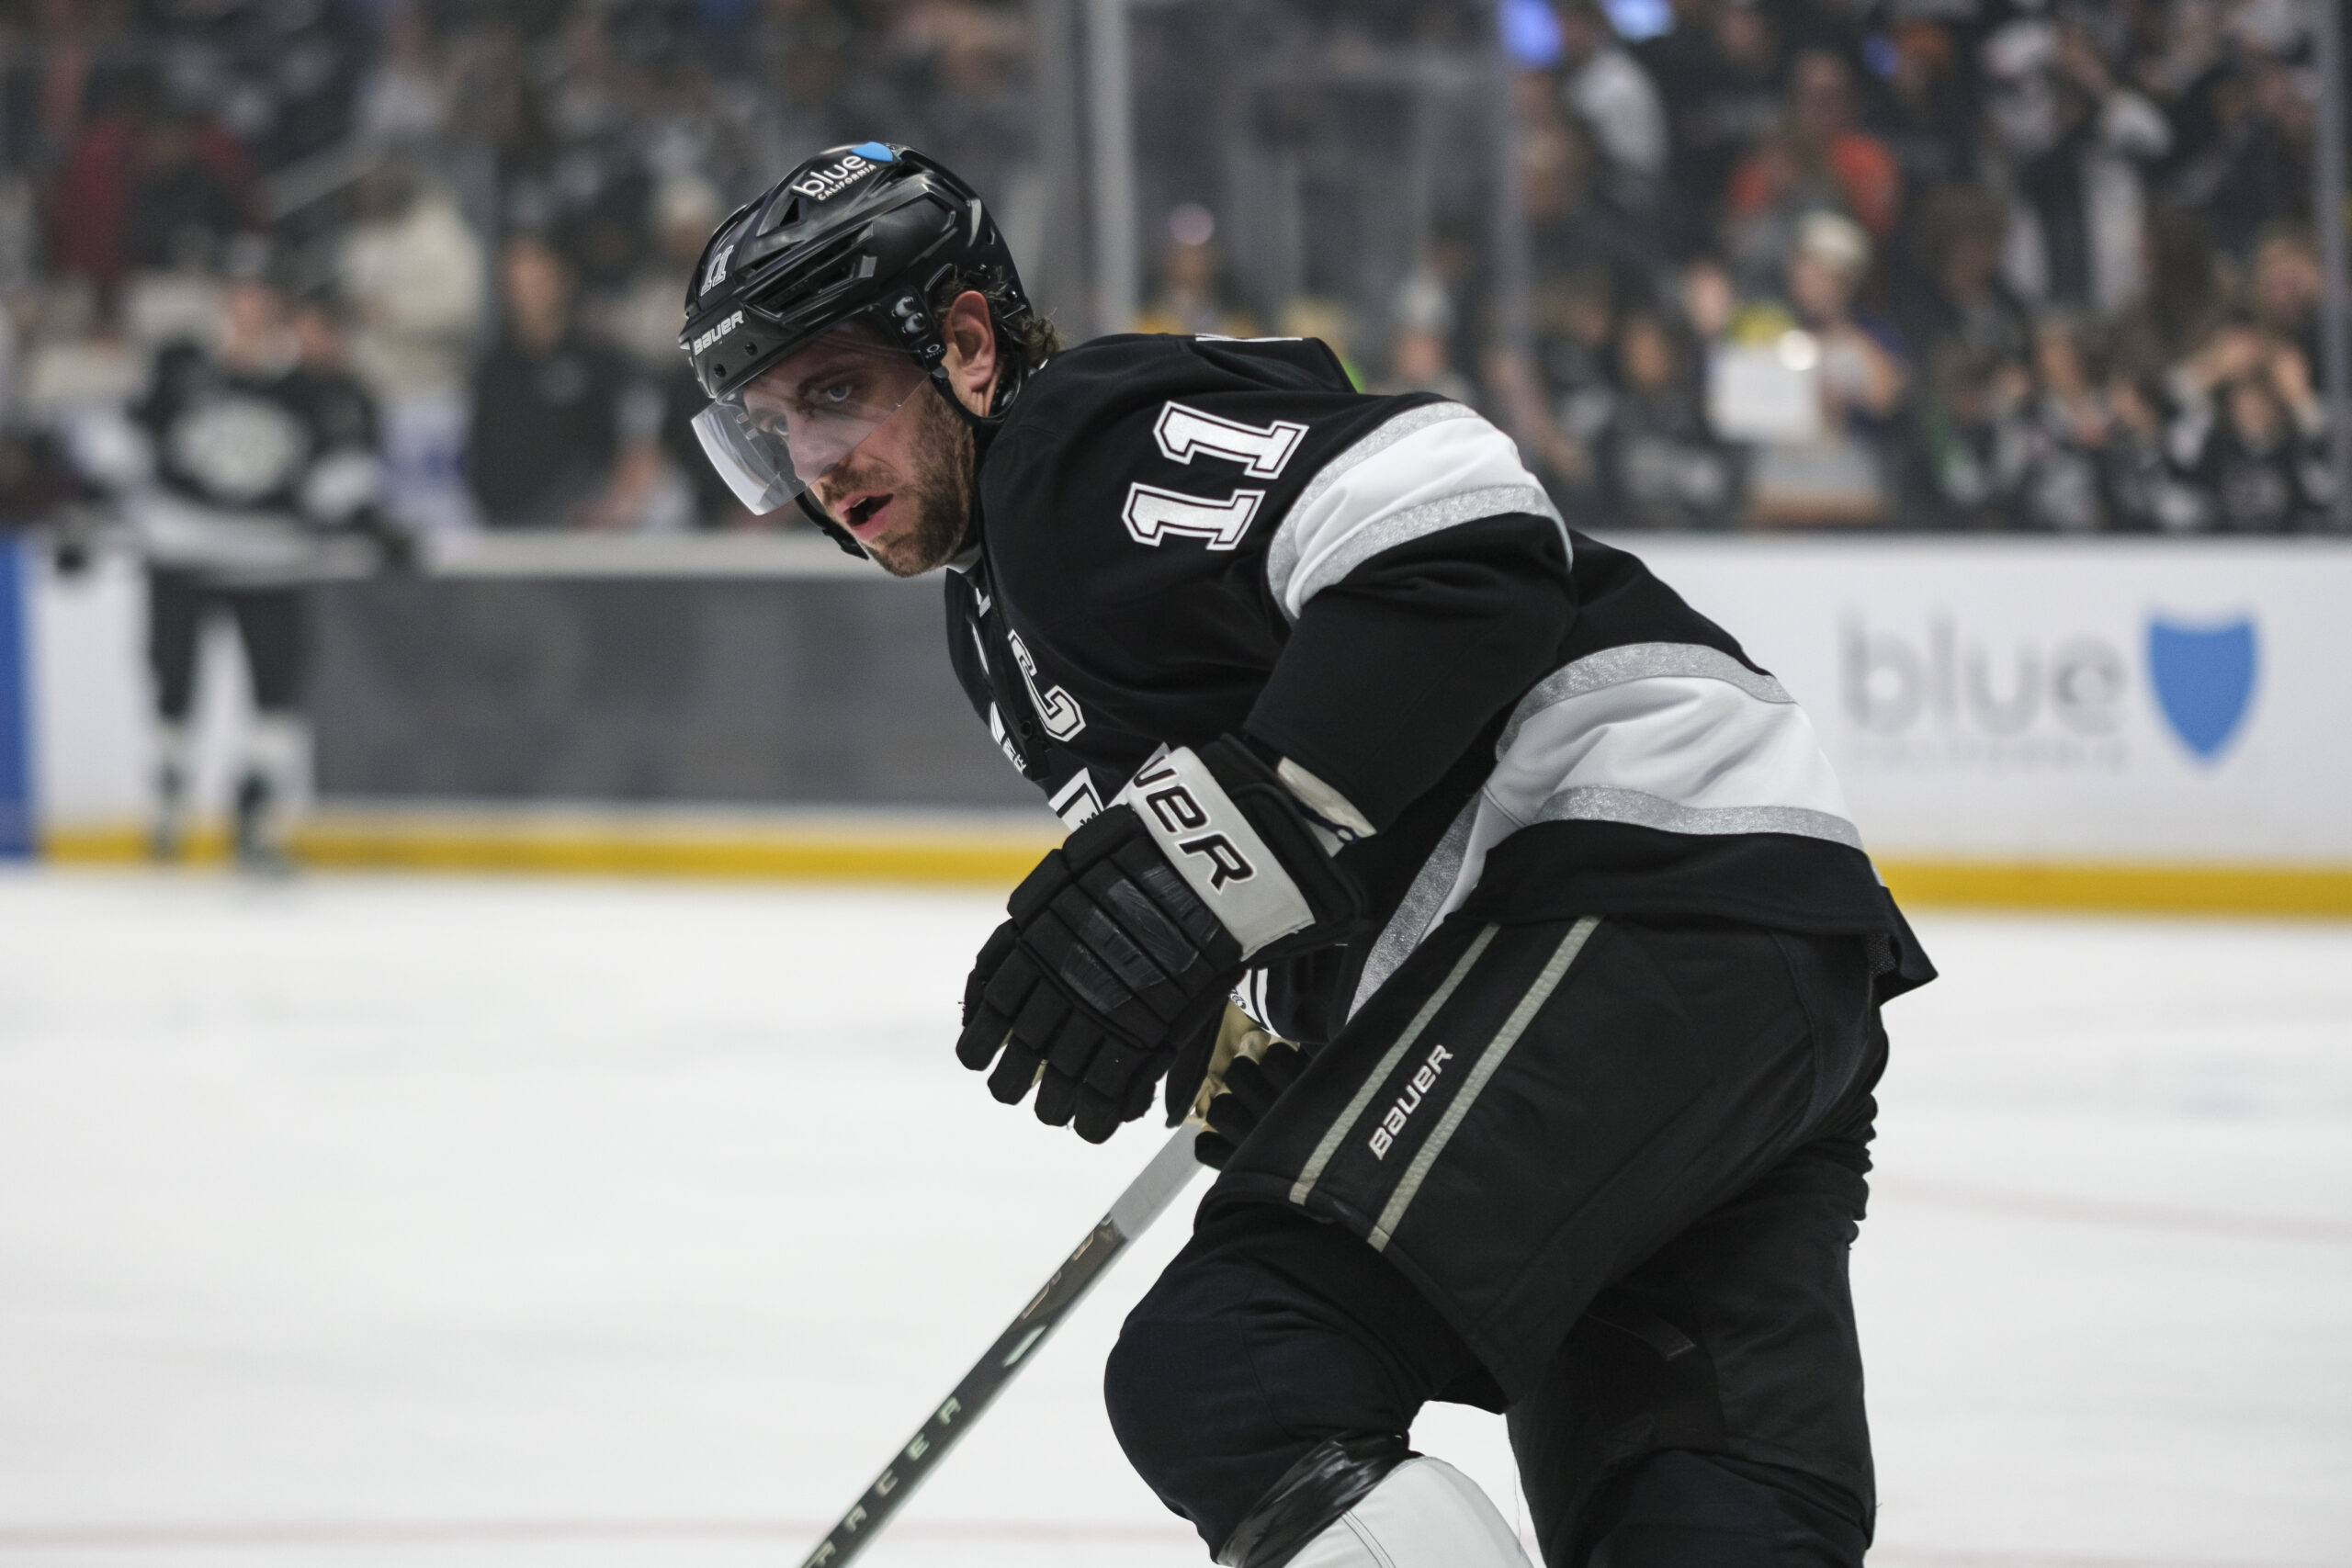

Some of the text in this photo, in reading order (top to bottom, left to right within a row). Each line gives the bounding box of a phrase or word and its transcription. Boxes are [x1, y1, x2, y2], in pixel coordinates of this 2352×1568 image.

[792, 155, 866, 197] blue
[818, 164, 877, 201] CALIFORNIA
[700, 244, 734, 297] 11
[1121, 400, 1310, 551] 11
[1007, 628, 1087, 742] C
[1838, 599, 2126, 738] blue
[801, 1395, 962, 1568] RACER
